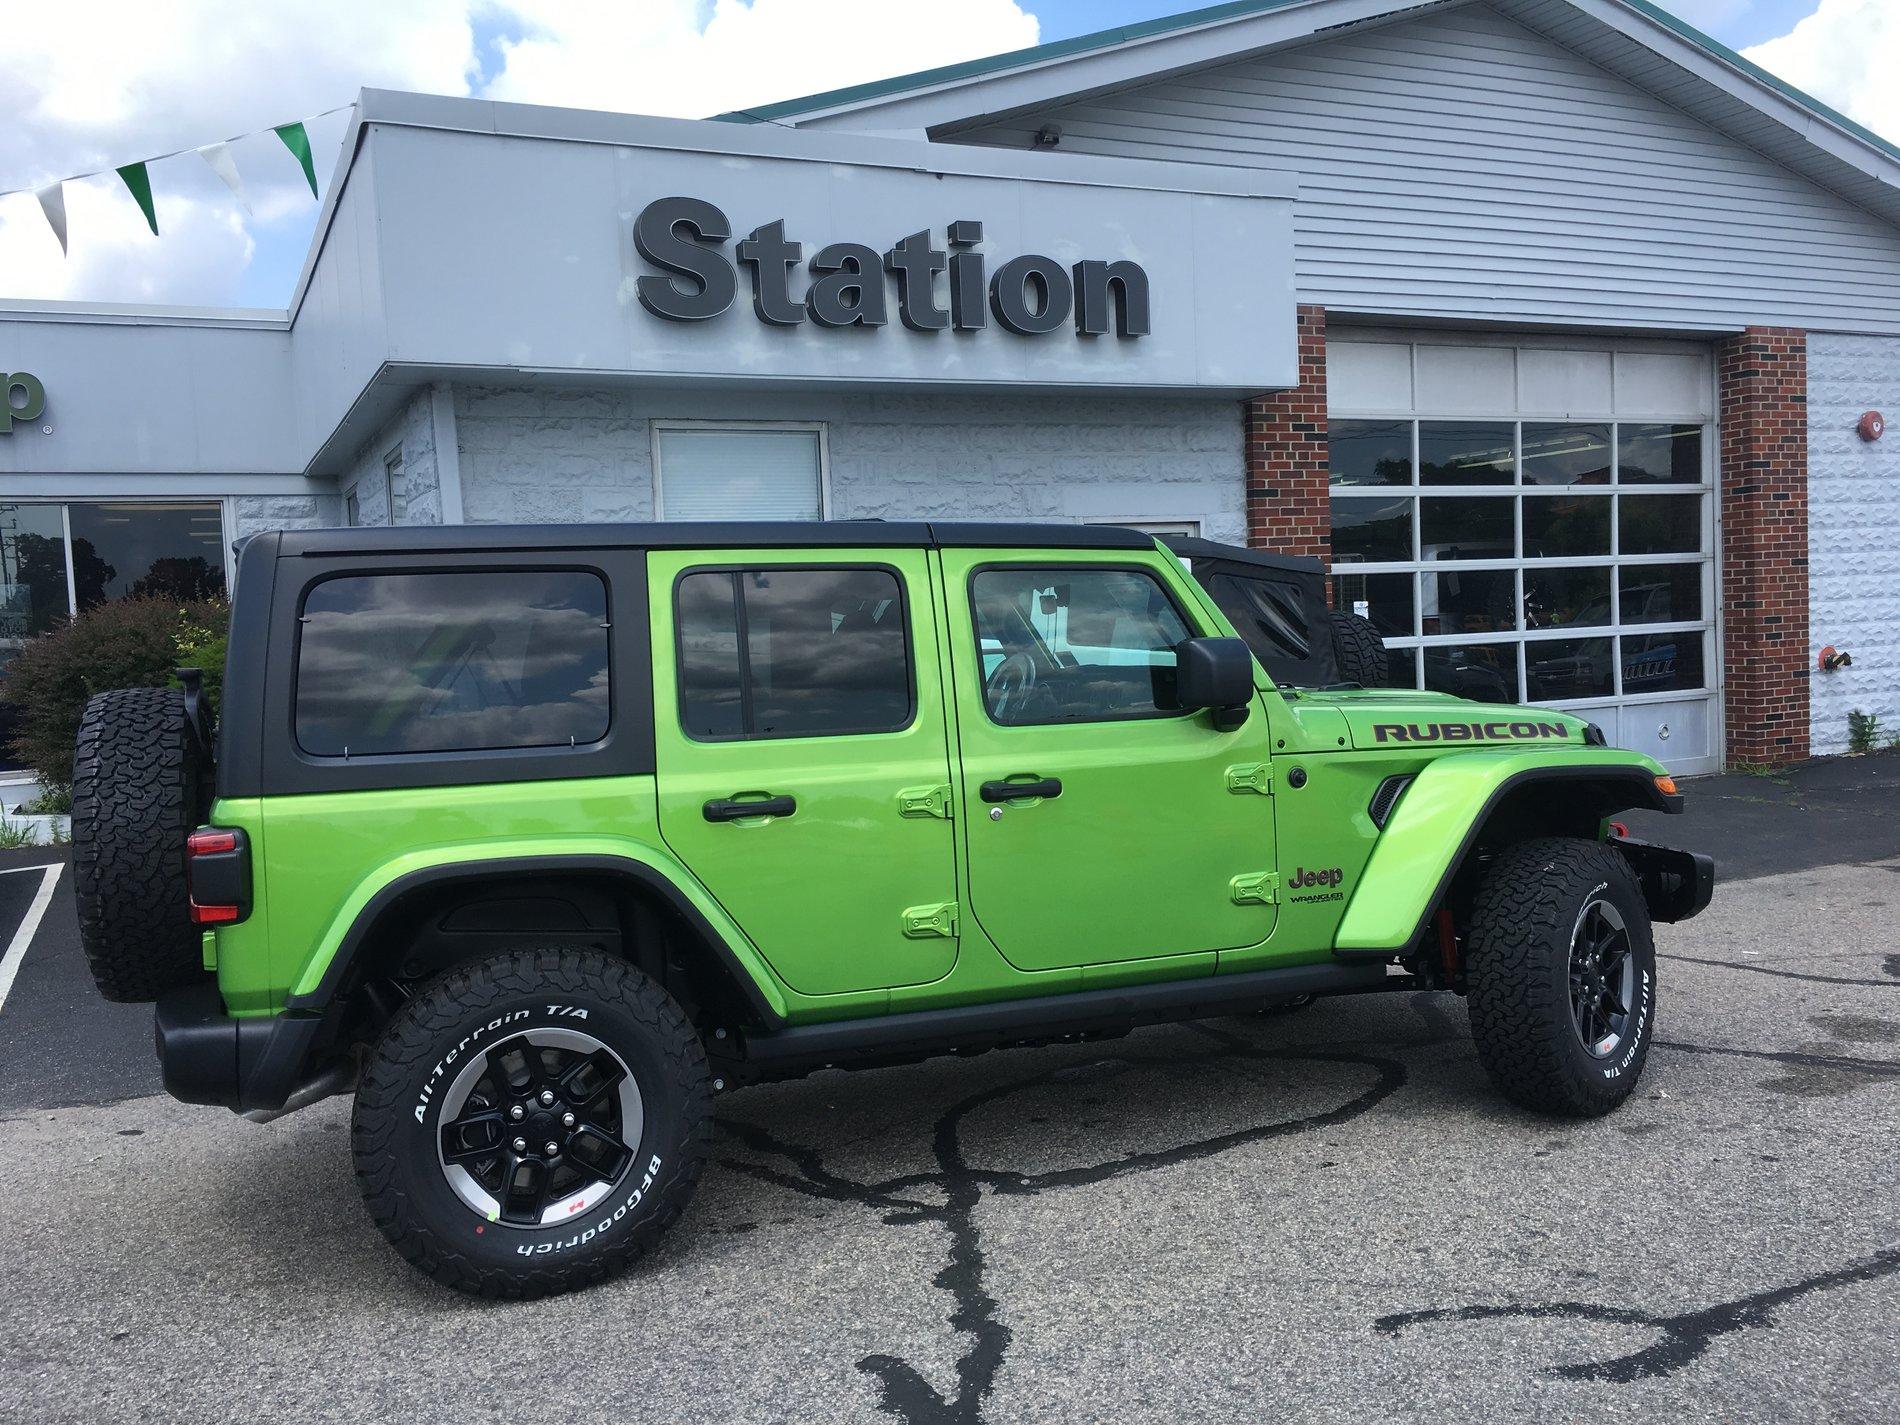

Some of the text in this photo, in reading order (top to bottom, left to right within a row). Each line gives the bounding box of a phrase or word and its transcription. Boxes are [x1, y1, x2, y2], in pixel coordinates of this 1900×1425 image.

[633, 196, 1151, 338] Station
[1373, 722, 1568, 742] RUBICON
[1289, 867, 1344, 889] Jeep
[1290, 892, 1344, 903] WRANGLER
[414, 1005, 590, 1124] All-Terrain T/A
[1621, 969, 1649, 1068] All-Terrain
[516, 1154, 662, 1257] BFGoodrich
